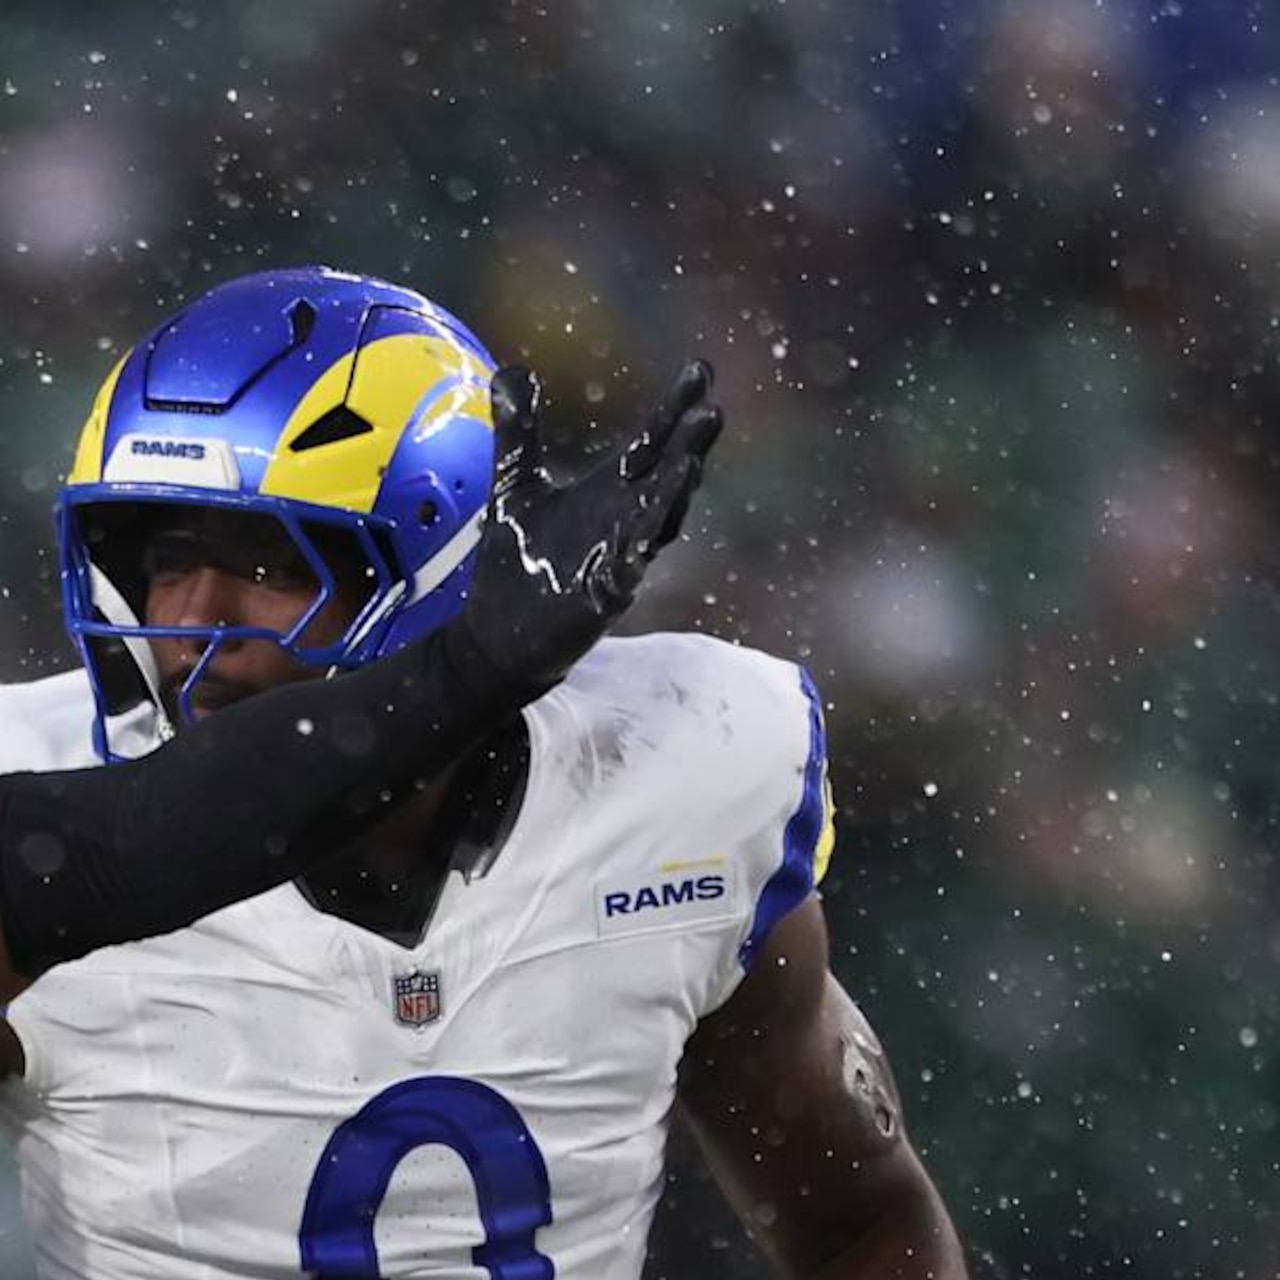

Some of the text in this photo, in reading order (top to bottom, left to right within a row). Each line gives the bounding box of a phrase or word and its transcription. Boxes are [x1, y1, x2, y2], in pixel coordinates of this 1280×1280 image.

[131, 441, 205, 459] RAMS
[605, 875, 725, 917] RAMS
[402, 994, 437, 1020] NFL
